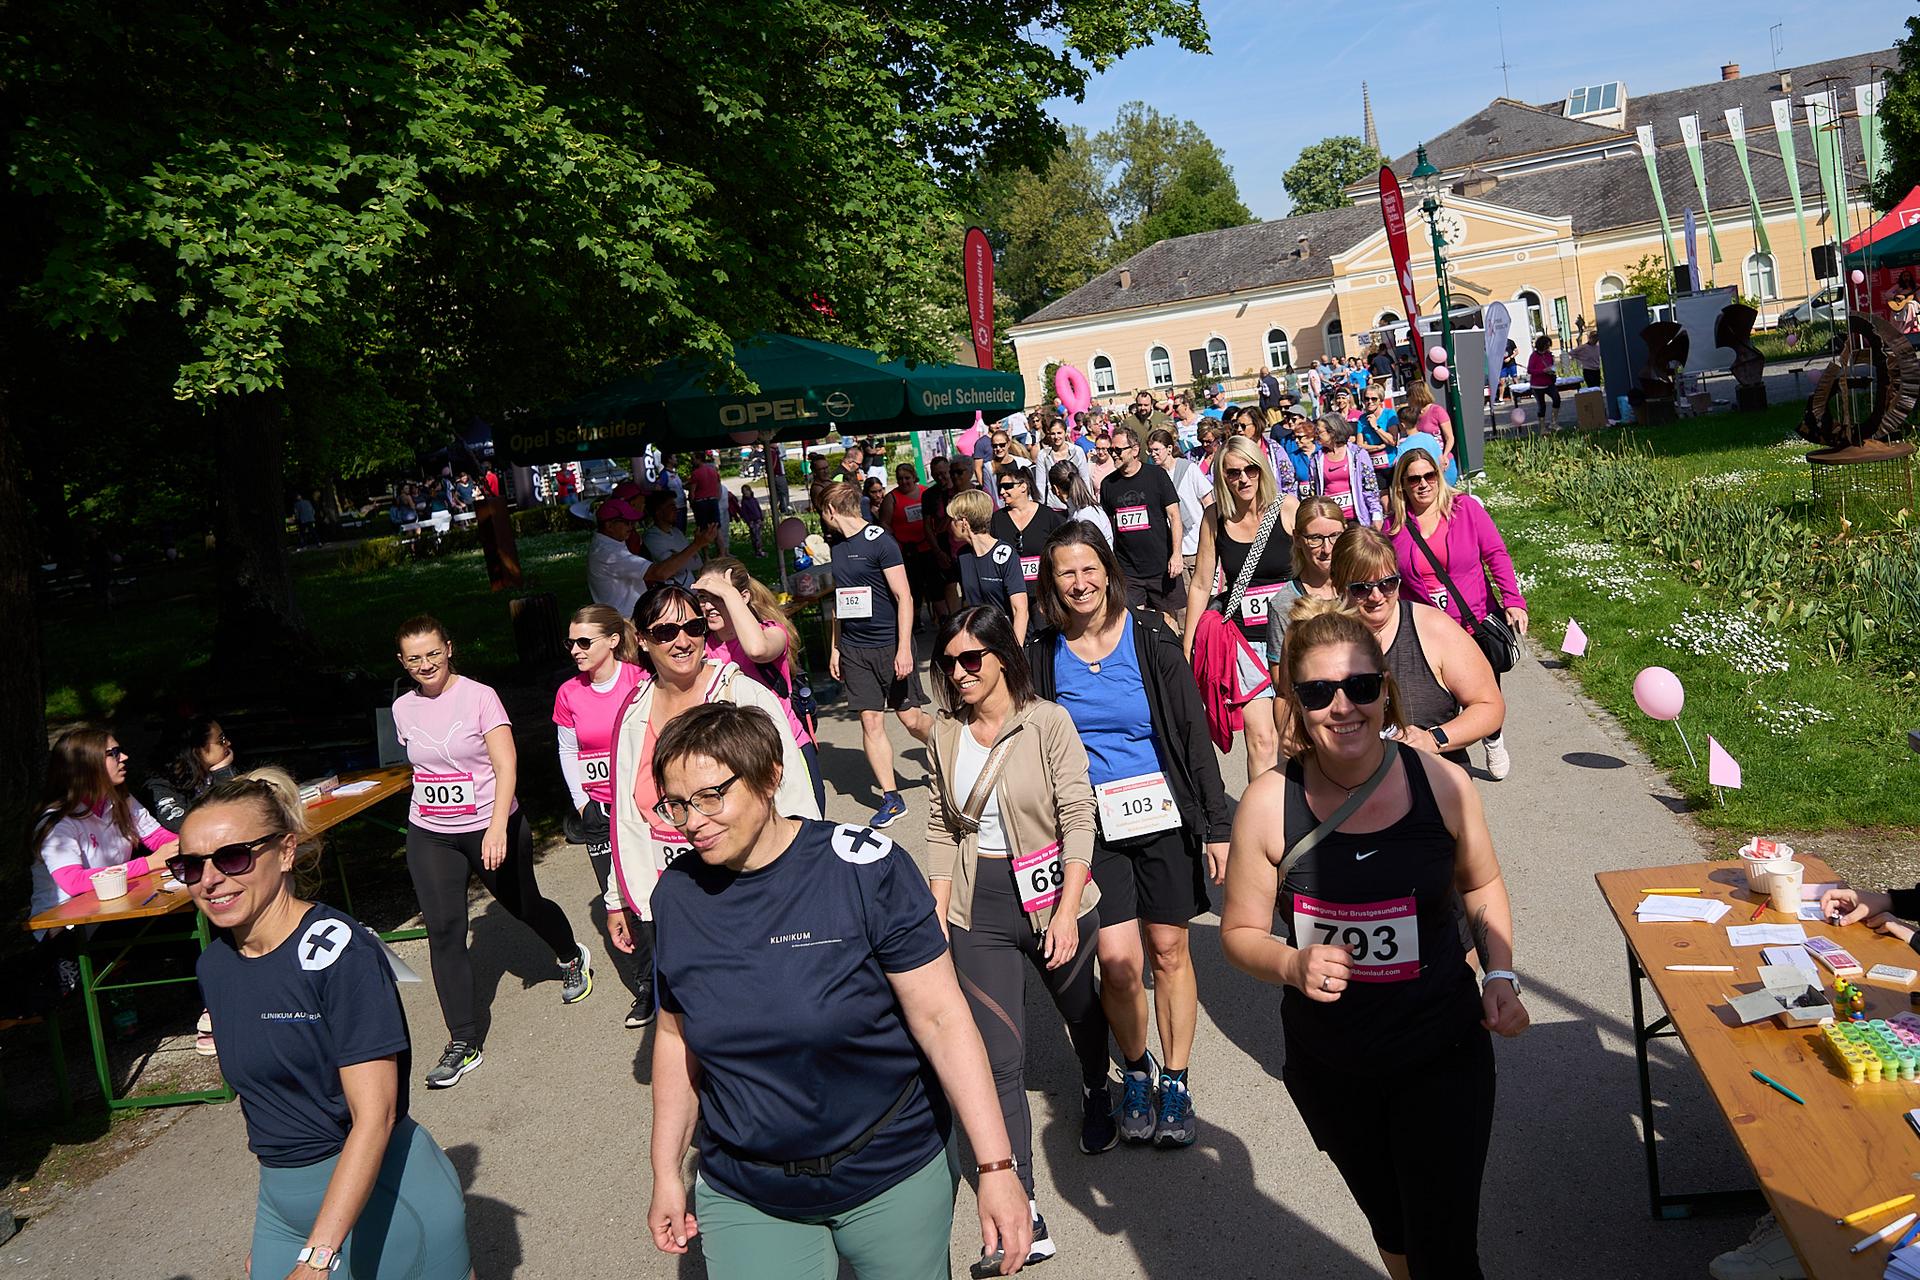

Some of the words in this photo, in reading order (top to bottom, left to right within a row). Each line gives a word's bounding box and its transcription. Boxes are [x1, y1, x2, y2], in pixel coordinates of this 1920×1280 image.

[975, 244, 986, 321] MeinBezirk.at
[922, 388, 952, 410] Opel
[955, 387, 1016, 405] Schneider
[719, 398, 818, 427] OPEL
[510, 431, 549, 454] Opel
[555, 419, 646, 444] Schneider
[1121, 512, 1142, 526] 677
[845, 596, 859, 606] 162
[1250, 596, 1270, 615] 81
[586, 761, 609, 780] 90
[424, 785, 464, 804] 903
[1121, 797, 1153, 817] 103
[1031, 860, 1065, 893] 68
[1302, 902, 1337, 917] Bewegung
[1338, 909, 1349, 917] für
[1350, 904, 1408, 918] Brustgesundheit
[770, 931, 811, 944] KLINIKUM
[1313, 922, 1399, 962] 793
